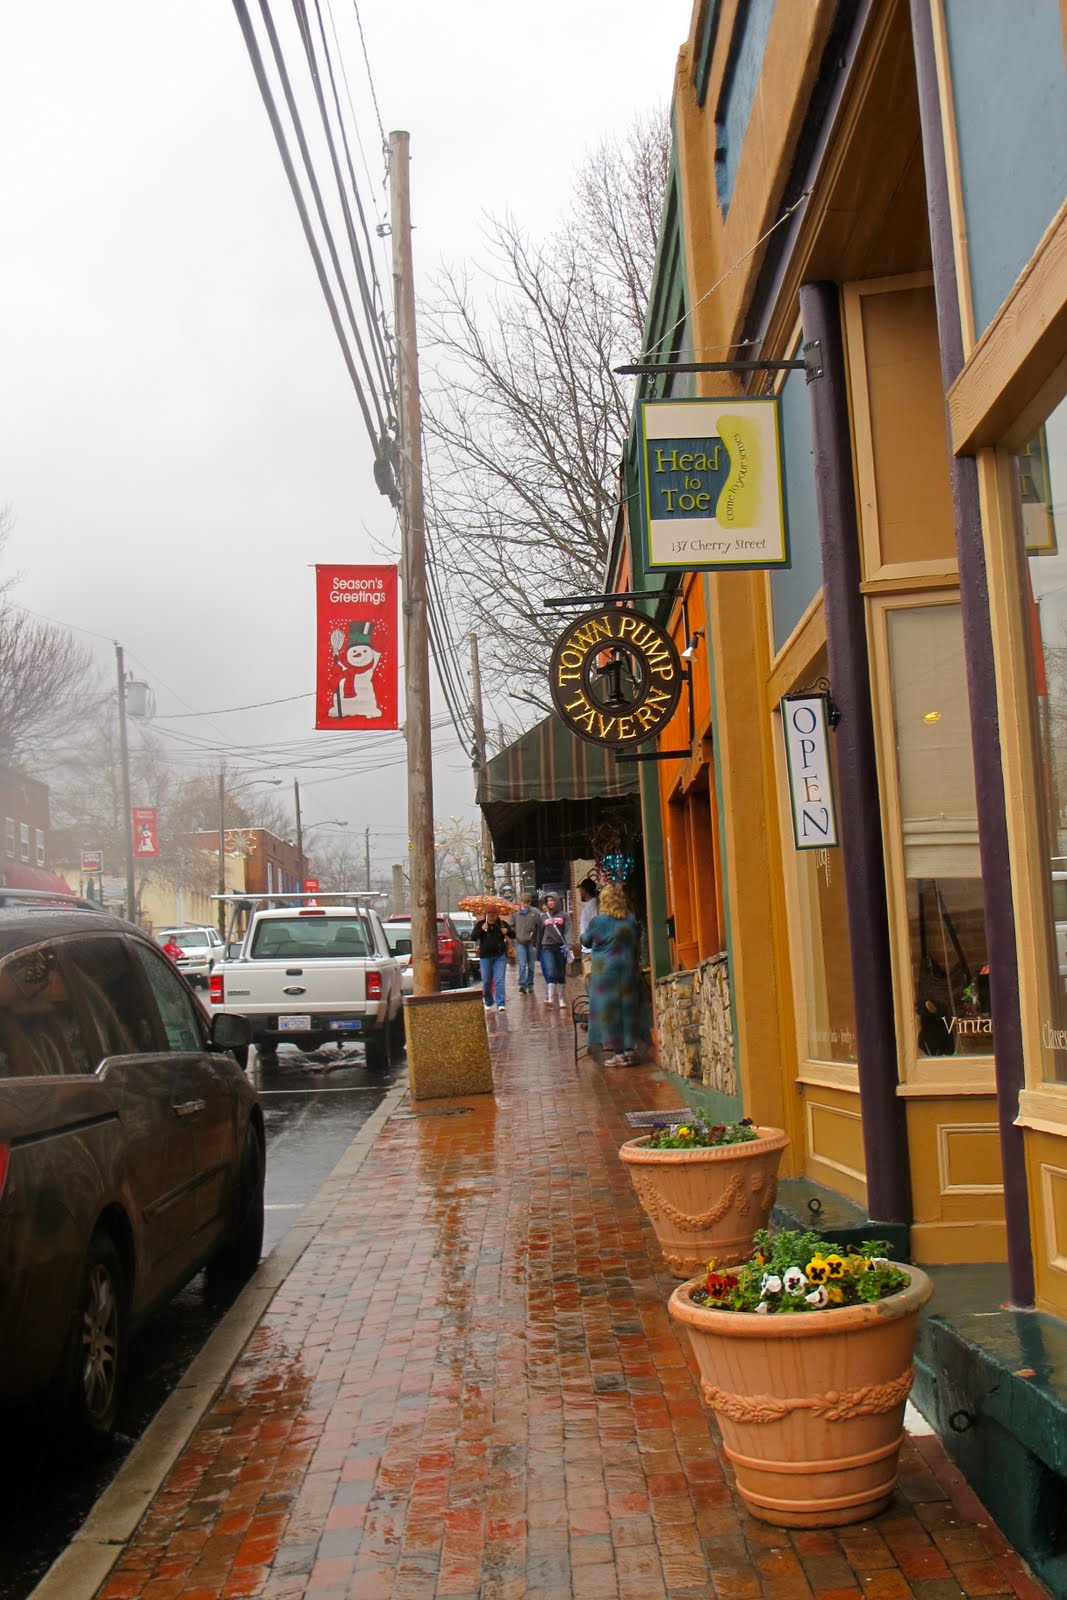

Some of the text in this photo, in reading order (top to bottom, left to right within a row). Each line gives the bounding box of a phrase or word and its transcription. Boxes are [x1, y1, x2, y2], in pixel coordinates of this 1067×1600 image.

[655, 446, 721, 473] Head
[684, 476, 701, 490] to
[736, 462, 748, 488] your
[661, 488, 711, 512] Toe
[728, 484, 739, 494] to
[726, 494, 735, 521] come
[671, 539, 766, 554] 137 Cherry Street
[332, 577, 383, 590] Season's
[329, 591, 385, 605] Greetings
[558, 616, 674, 687] TOWN PUMP
[565, 685, 672, 740] TAVERN
[793, 707, 829, 836] OPEN
